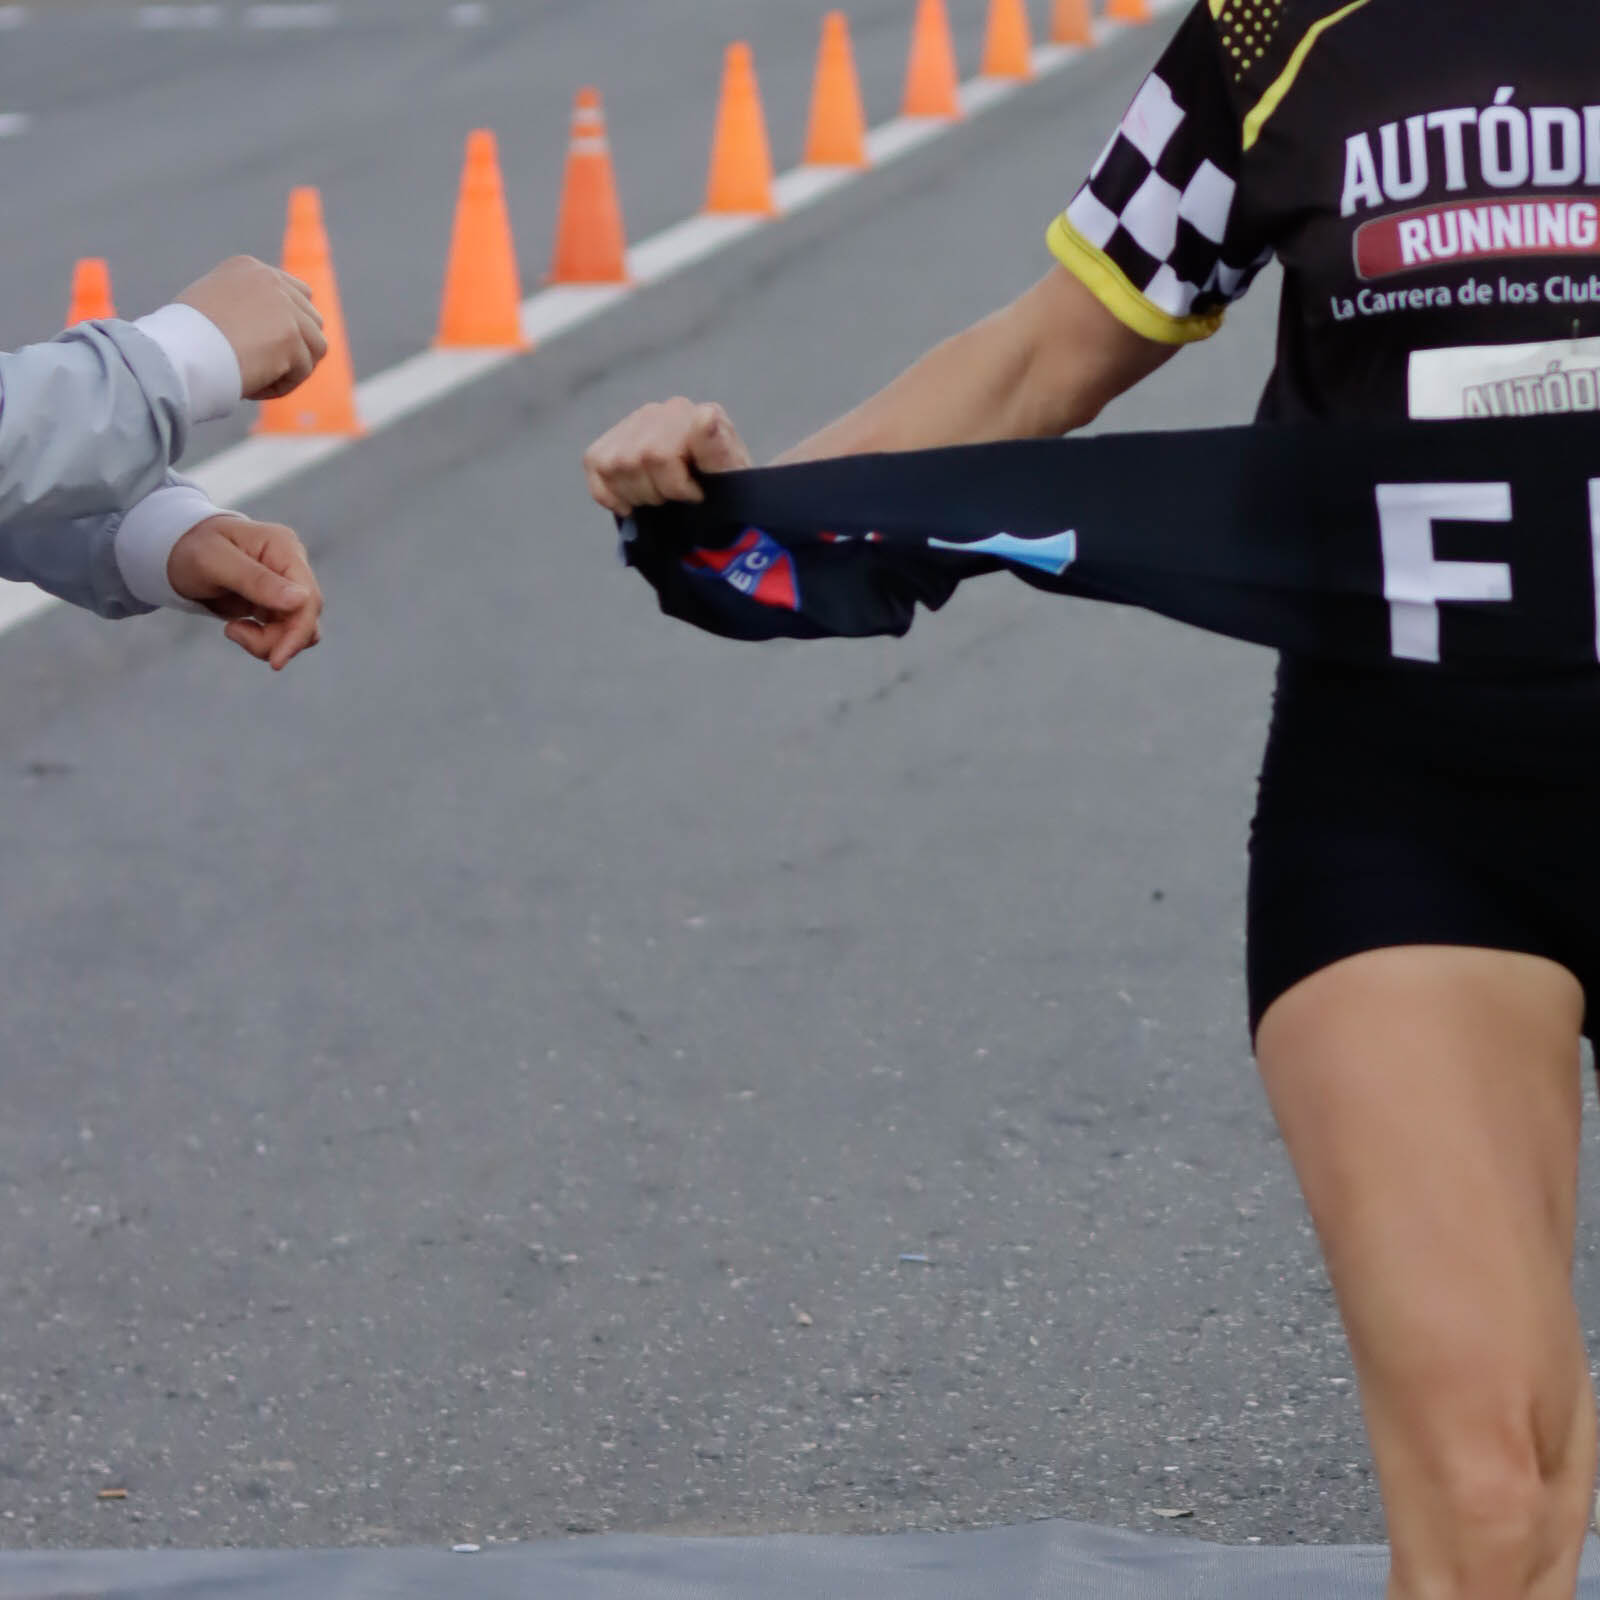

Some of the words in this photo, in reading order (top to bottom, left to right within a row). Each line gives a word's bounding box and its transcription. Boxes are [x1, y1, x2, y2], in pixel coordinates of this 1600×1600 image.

[1399, 203, 1598, 265] RUNNING
[1331, 296, 1356, 321] La
[1357, 286, 1452, 315] Carrera
[1458, 277, 1493, 304] de
[1499, 276, 1539, 302] los
